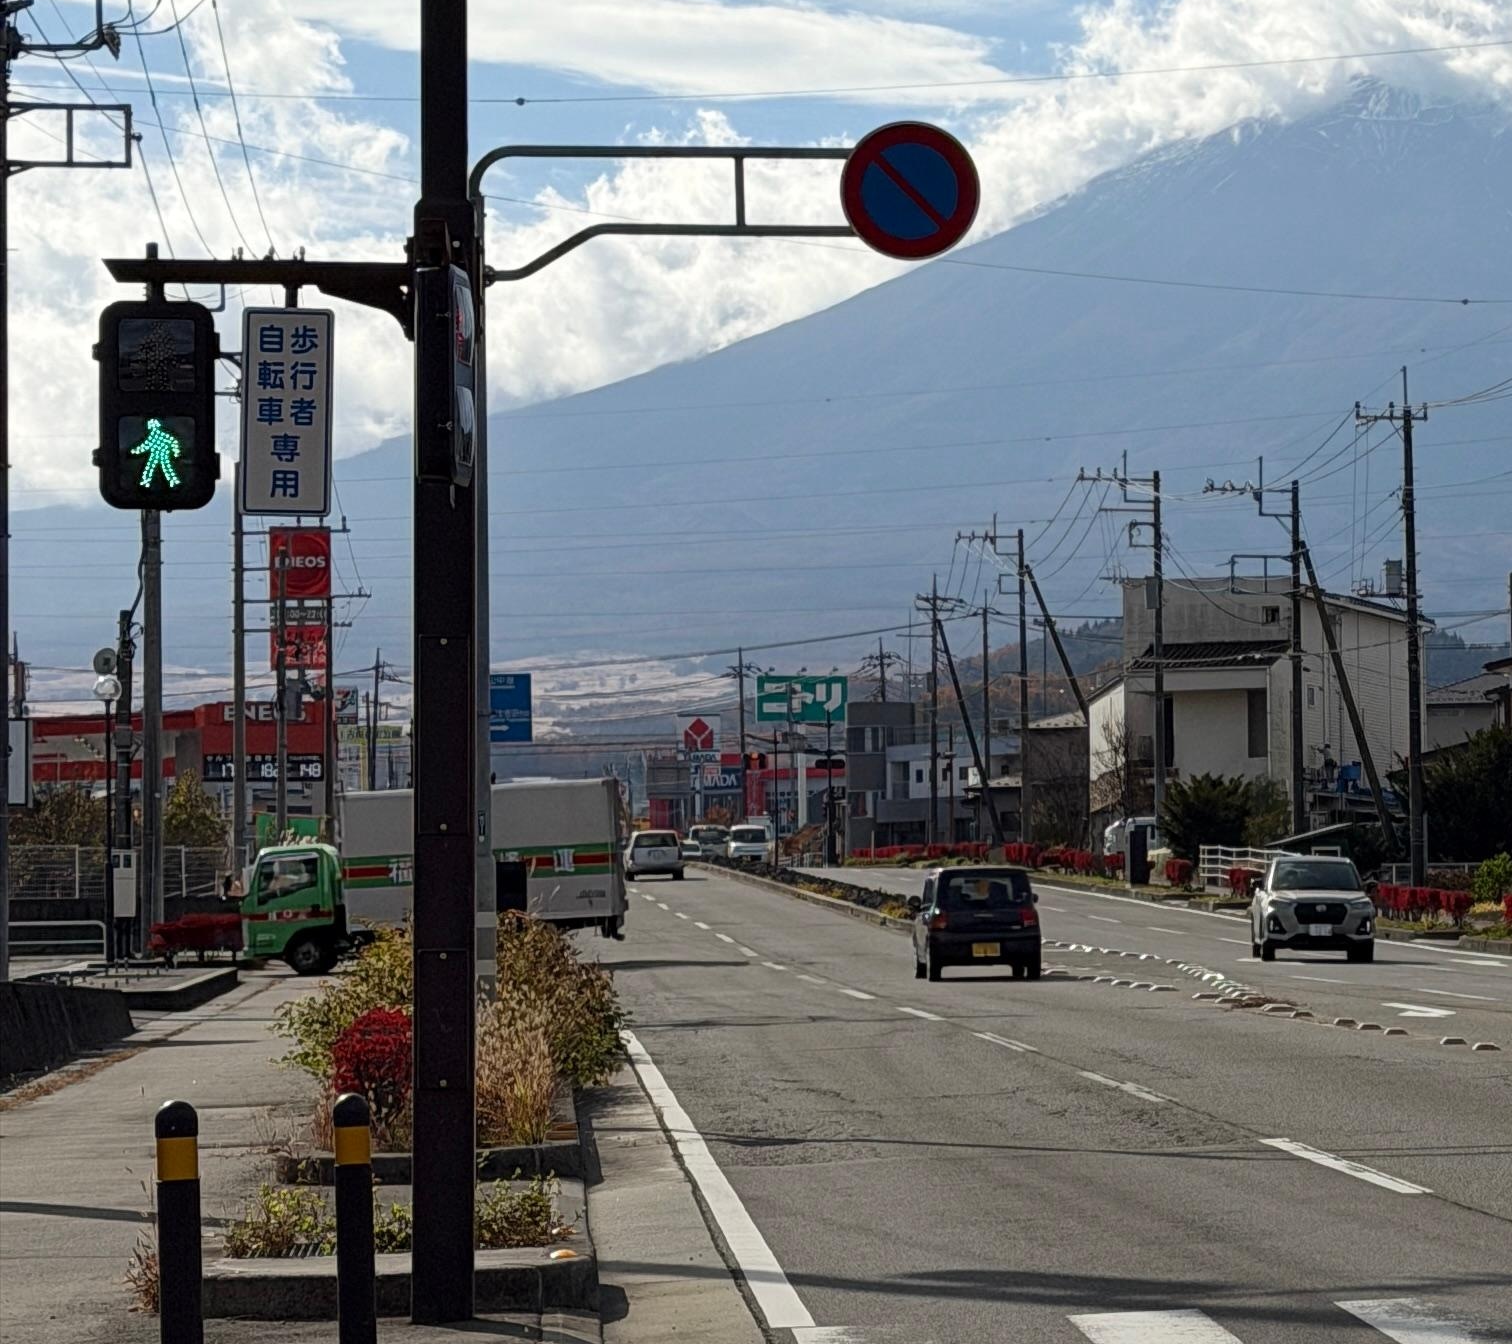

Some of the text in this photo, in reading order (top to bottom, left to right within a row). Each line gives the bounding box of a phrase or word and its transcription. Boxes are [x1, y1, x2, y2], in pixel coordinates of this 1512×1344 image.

[256, 324, 285, 426] 自転車
[290, 325, 319, 426] 歩行者
[270, 433, 301, 498] 専用
[763, 683, 842, 713] ニトリ
[300, 763, 321, 777] 148
